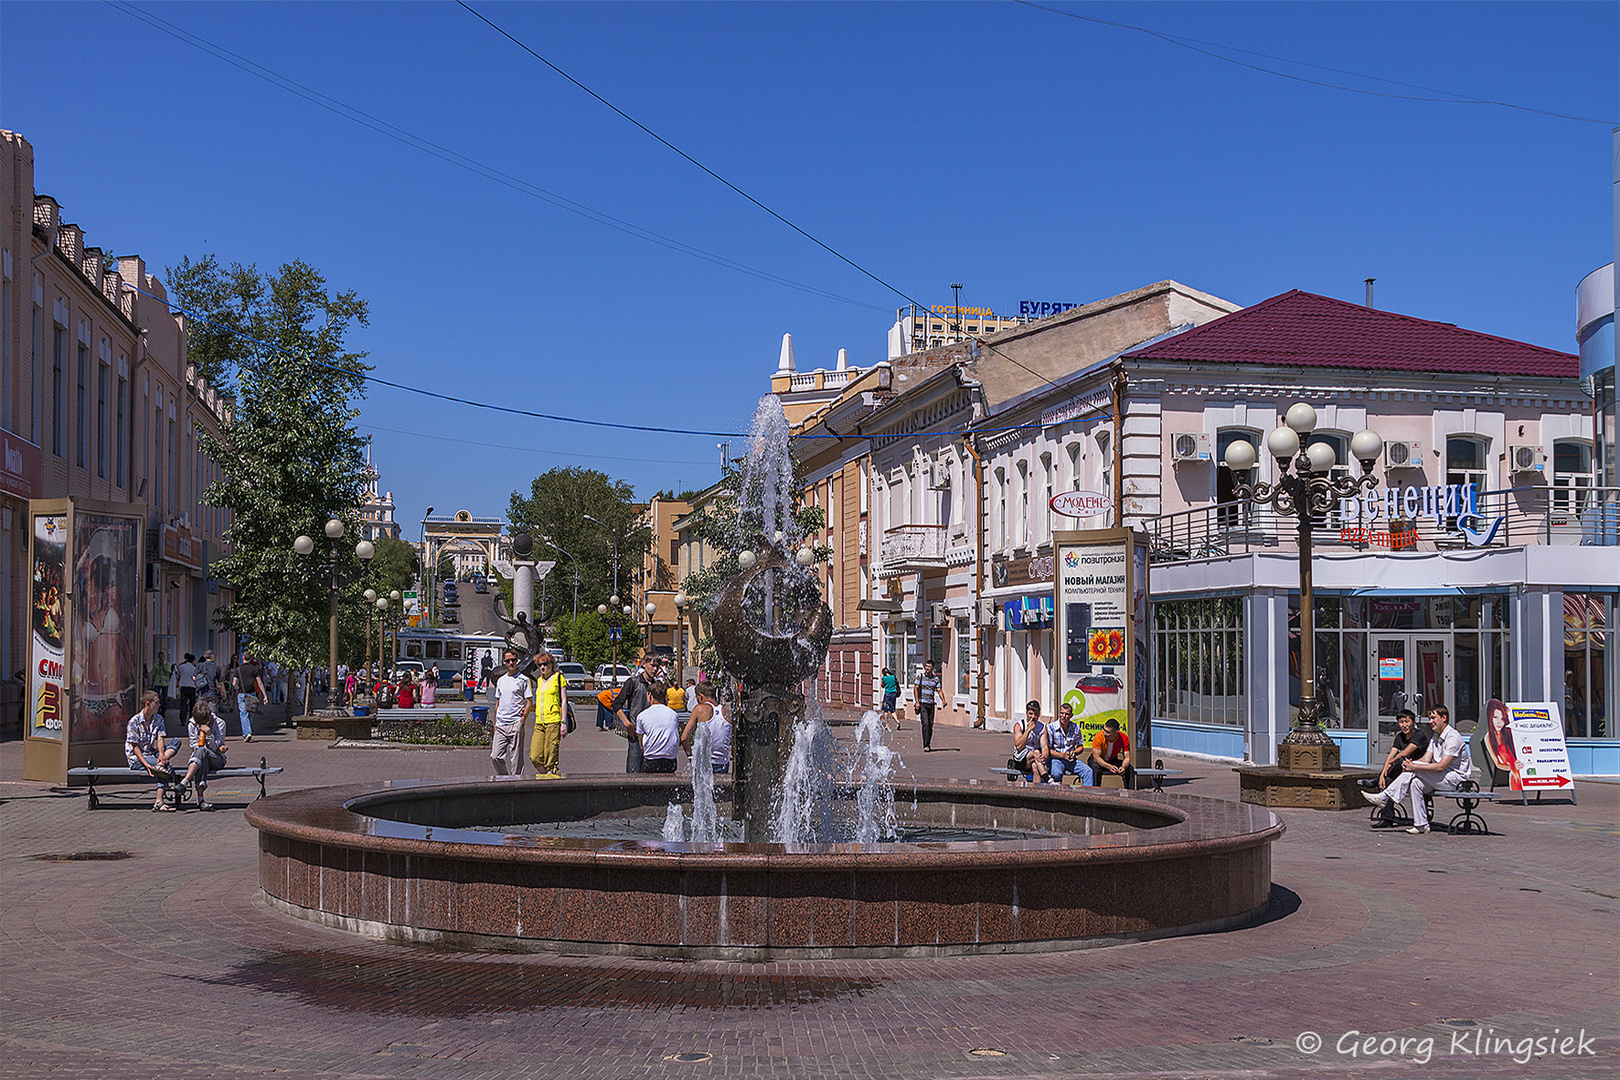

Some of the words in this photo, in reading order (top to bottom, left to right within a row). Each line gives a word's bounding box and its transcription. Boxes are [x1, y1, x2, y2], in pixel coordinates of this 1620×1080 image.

[931, 304, 993, 317] ГОСТИНИЦА
[1064, 574, 1094, 586] НОВЫЙ
[1095, 574, 1126, 586] МАГАЗИН
[39, 658, 64, 680] СМО
